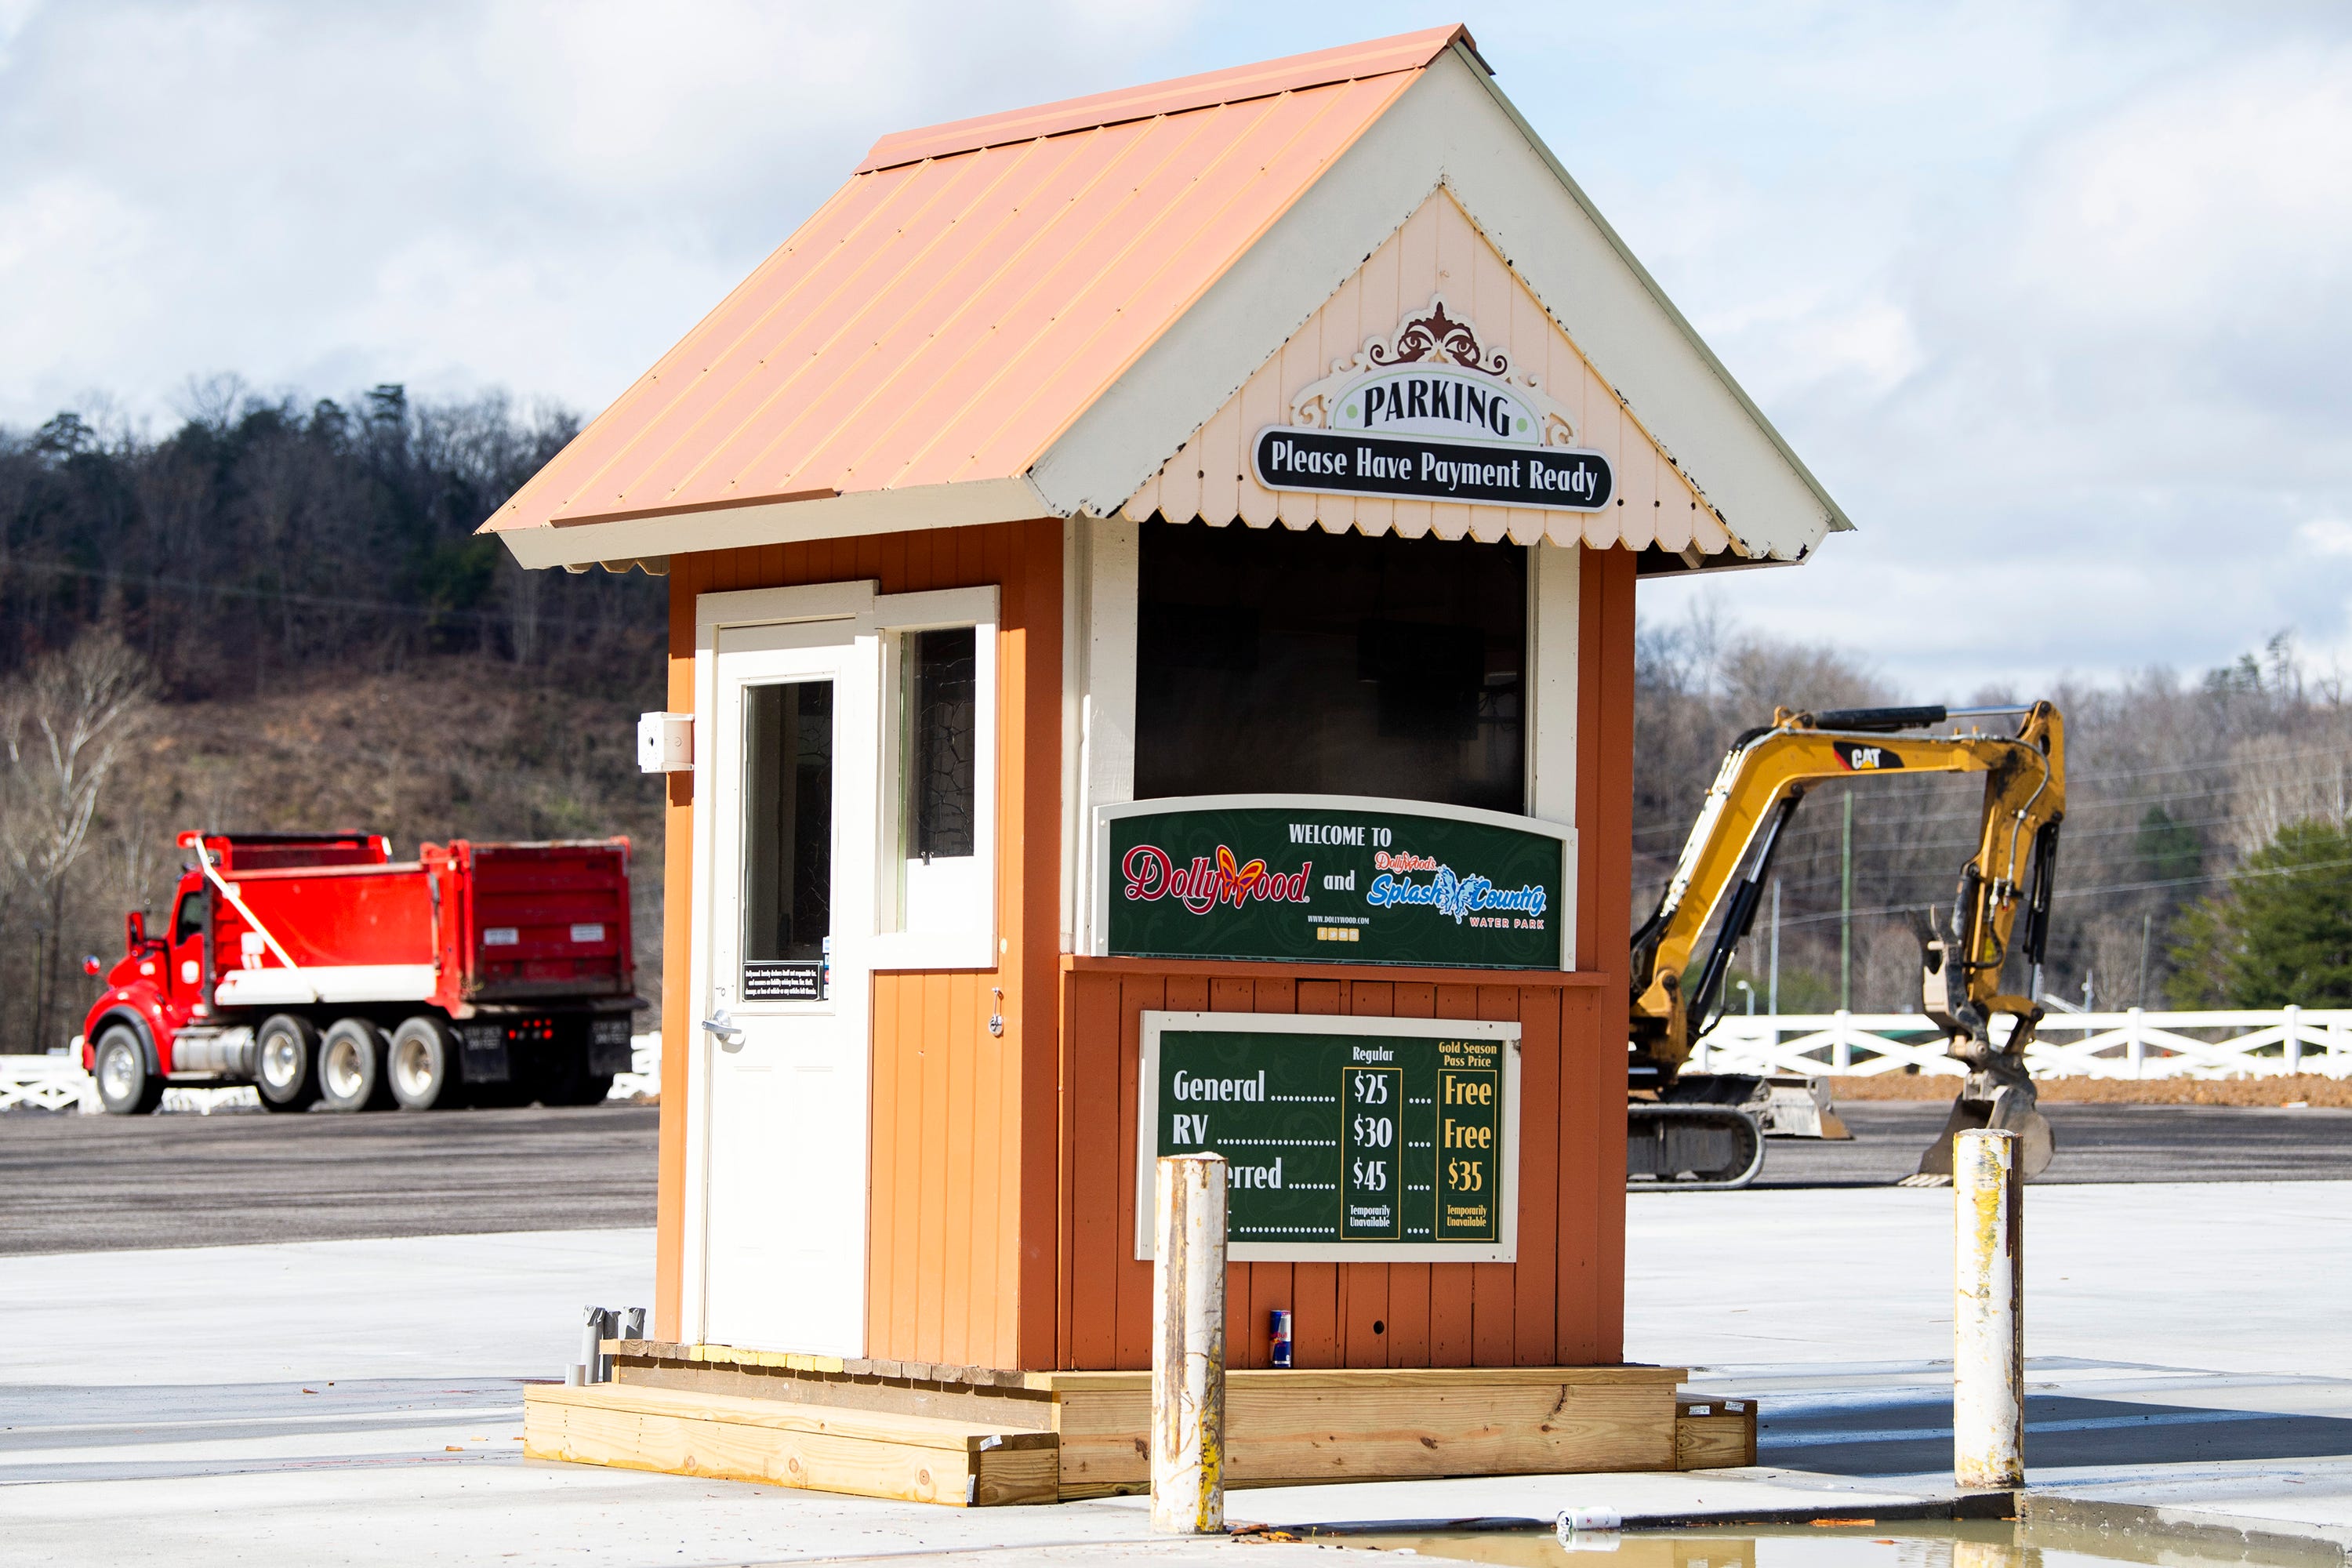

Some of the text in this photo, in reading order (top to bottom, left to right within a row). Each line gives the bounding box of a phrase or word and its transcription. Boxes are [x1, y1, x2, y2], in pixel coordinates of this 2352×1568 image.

[1363, 379, 1511, 437] PARKING
[1271, 440, 1598, 501] Please Have Payment Ready
[1851, 748, 1882, 770] CAT
[1289, 823, 1392, 848] WELCOME TO
[1323, 869, 1356, 891] and
[1367, 873, 1547, 917] Splash Country
[1307, 915, 1370, 925] WWW.DOLLYWOOD.COM
[1469, 916, 1544, 930] WATER PARK
[1352, 1046, 1394, 1064] Regular
[1439, 1041, 1497, 1054] Gold Season
[1443, 1054, 1491, 1067] Pass Price
[1173, 1069, 1492, 1105] General $25 Free
[1172, 1113, 1491, 1149] RV $30 Free
[1353, 1156, 1387, 1191] $45
[1448, 1157, 1483, 1192] $35
[1349, 1204, 1391, 1218] Temporarily
[1446, 1204, 1487, 1218] Temporarily
[1349, 1217, 1390, 1228] Unavailable
[1446, 1216, 1486, 1228] Unavailable
